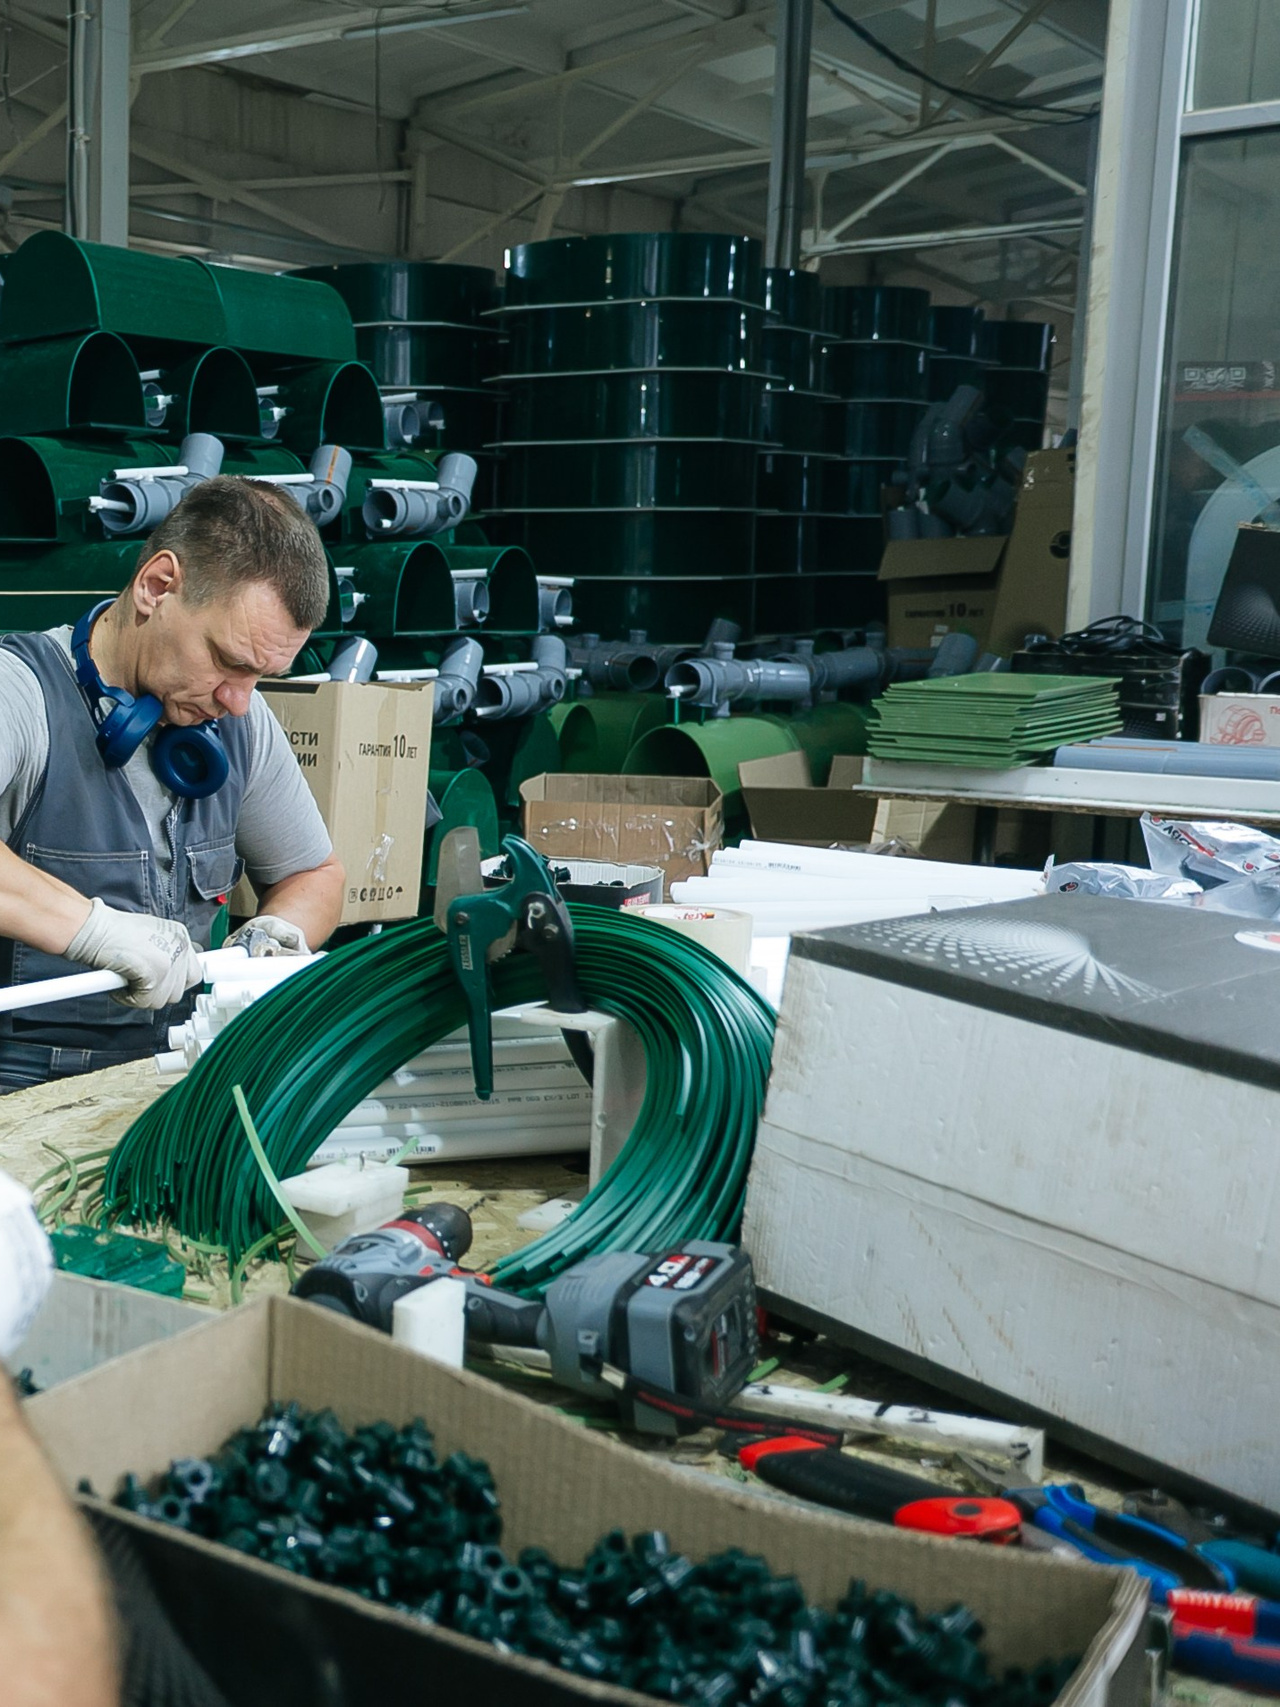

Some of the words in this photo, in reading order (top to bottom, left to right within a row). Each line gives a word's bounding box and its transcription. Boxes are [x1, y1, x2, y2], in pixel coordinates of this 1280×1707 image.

[949, 603, 966, 617] 10
[284, 730, 319, 746] СТИ
[359, 742, 391, 757] ГАРАНТИЯ
[393, 734, 406, 758] 10
[406, 746, 418, 759] ЛЕТ
[294, 752, 317, 767] ИИ
